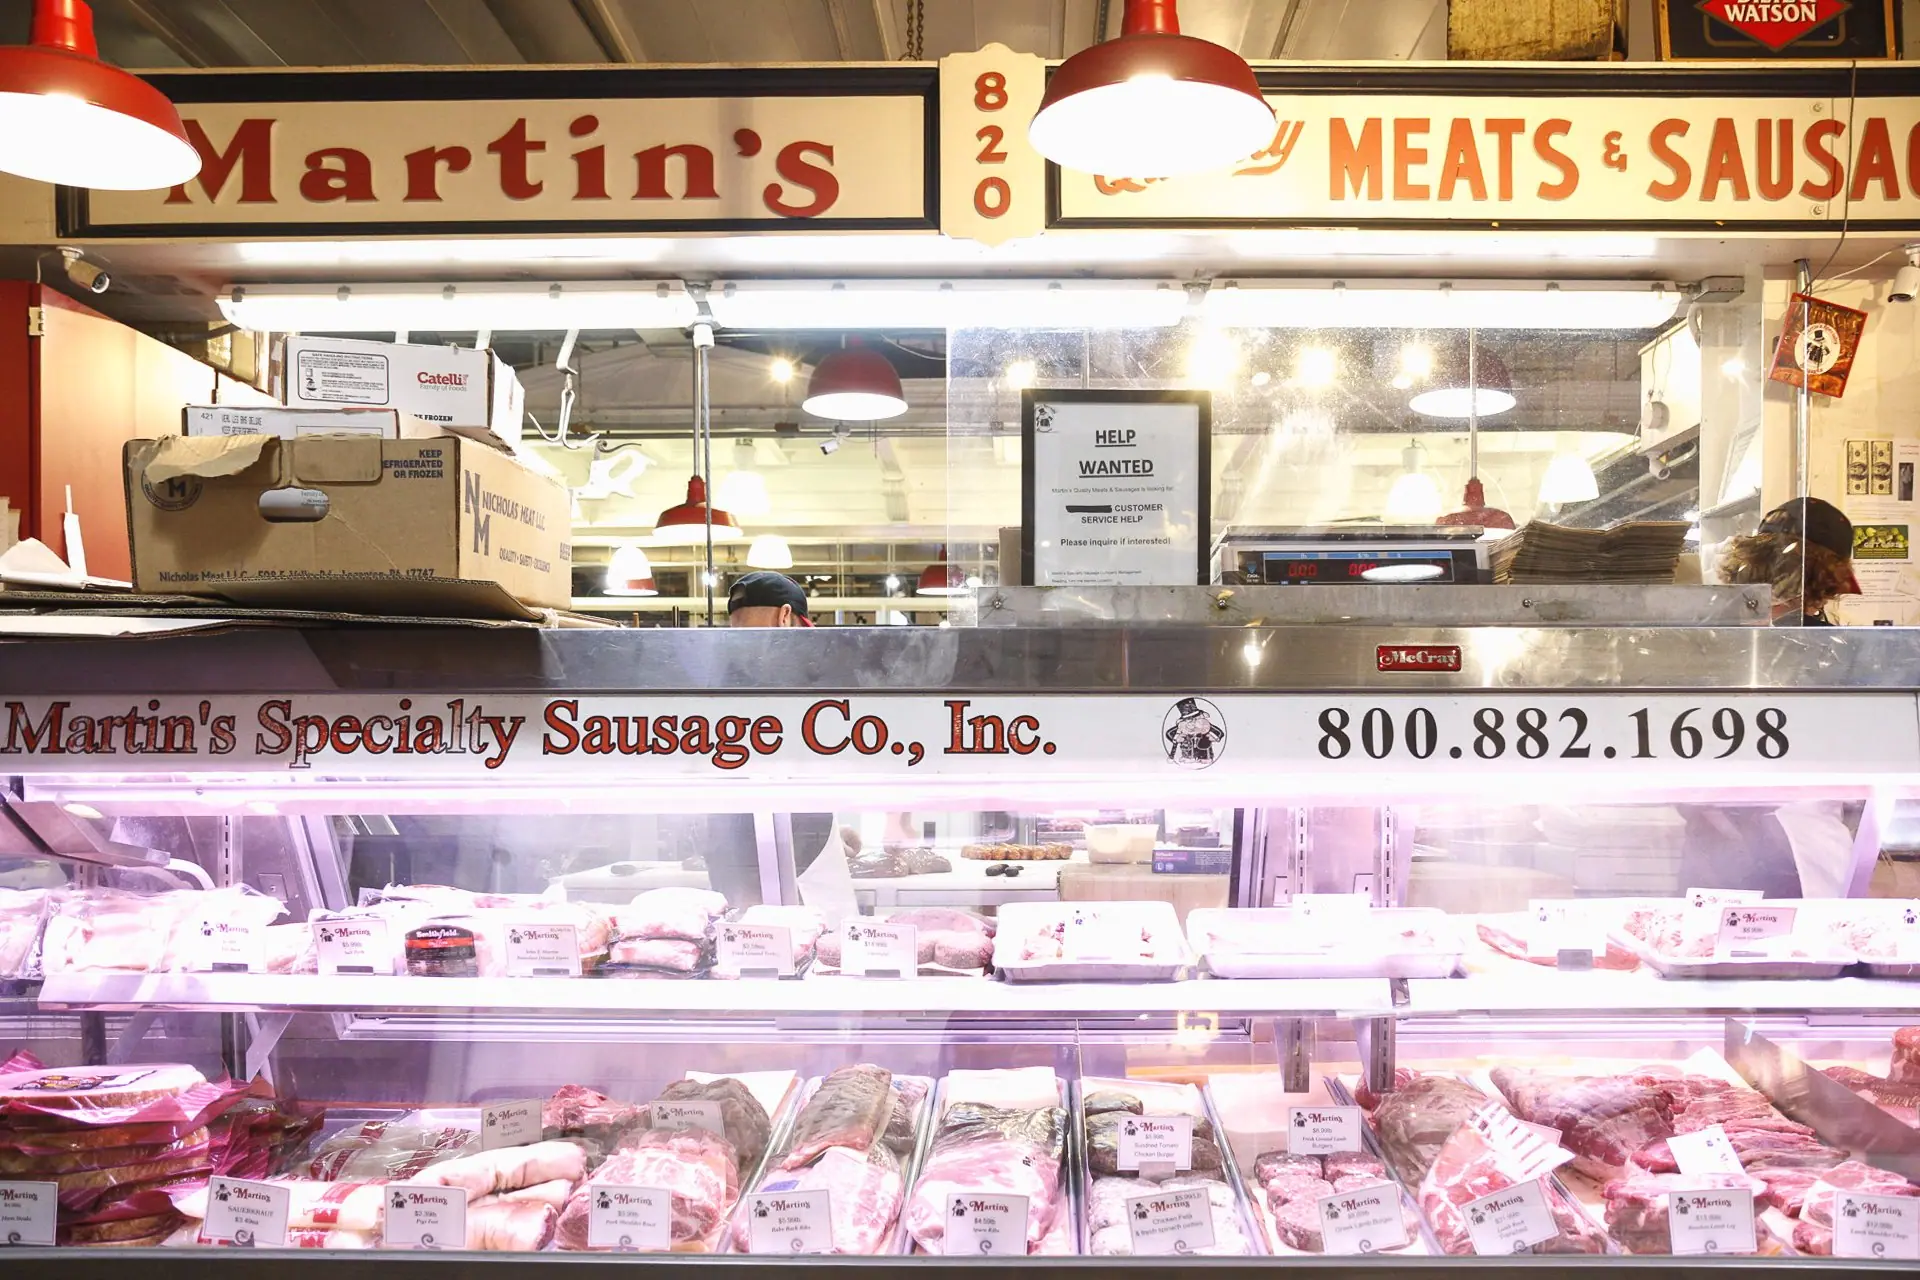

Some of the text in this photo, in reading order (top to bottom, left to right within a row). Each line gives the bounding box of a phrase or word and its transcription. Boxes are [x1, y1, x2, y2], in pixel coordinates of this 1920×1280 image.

[1724, 4, 1816, 22] WATSON
[164, 115, 840, 218] Martin's
[1328, 118, 1579, 202] MEATS
[1601, 130, 1627, 172] &
[417, 371, 463, 386] Catelli
[200, 412, 213, 420] 421
[424, 414, 453, 422] FROZEN
[1095, 429, 1136, 445] HELP
[419, 449, 442, 458] KEEP
[383, 460, 443, 468] EFRIGERATED
[1079, 459, 1154, 475] WANTED
[393, 470, 443, 478] OR FROZEN
[482, 490, 518, 520] NICHOLAS
[519, 505, 535, 526] MEAT
[1060, 538, 1087, 546] Please
[1090, 538, 1118, 548] inquire
[1127, 537, 1170, 545] interested!
[159, 571, 199, 581] Nicholas
[1379, 650, 1457, 667] McCray
[1, 699, 1057, 770] Martin's Specialty Sausage Co., Inc.
[1317, 707, 1790, 760] 800.882.1698
[334, 927, 371, 937] Martin's
[416, 929, 457, 938] Smithfield
[523, 930, 559, 940] Martin's
[1308, 1113, 1343, 1123] Martin's
[1139, 1122, 1174, 1132] Martin's
[233, 1187, 271, 1202] Martin's
[408, 1193, 448, 1205] Martin's
[614, 1193, 653, 1206] Martin's
[771, 1200, 811, 1211] Martin's
[969, 1200, 1009, 1213] Martin's
[1150, 1200, 1191, 1213] Martin's
[1341, 1198, 1380, 1211] Martin's
[1484, 1196, 1525, 1214] Martin's
[1692, 1197, 1732, 1208] Martin's
[227, 1206, 274, 1217] SAUERKRAUT
[1861, 1202, 1902, 1217] Martin's
